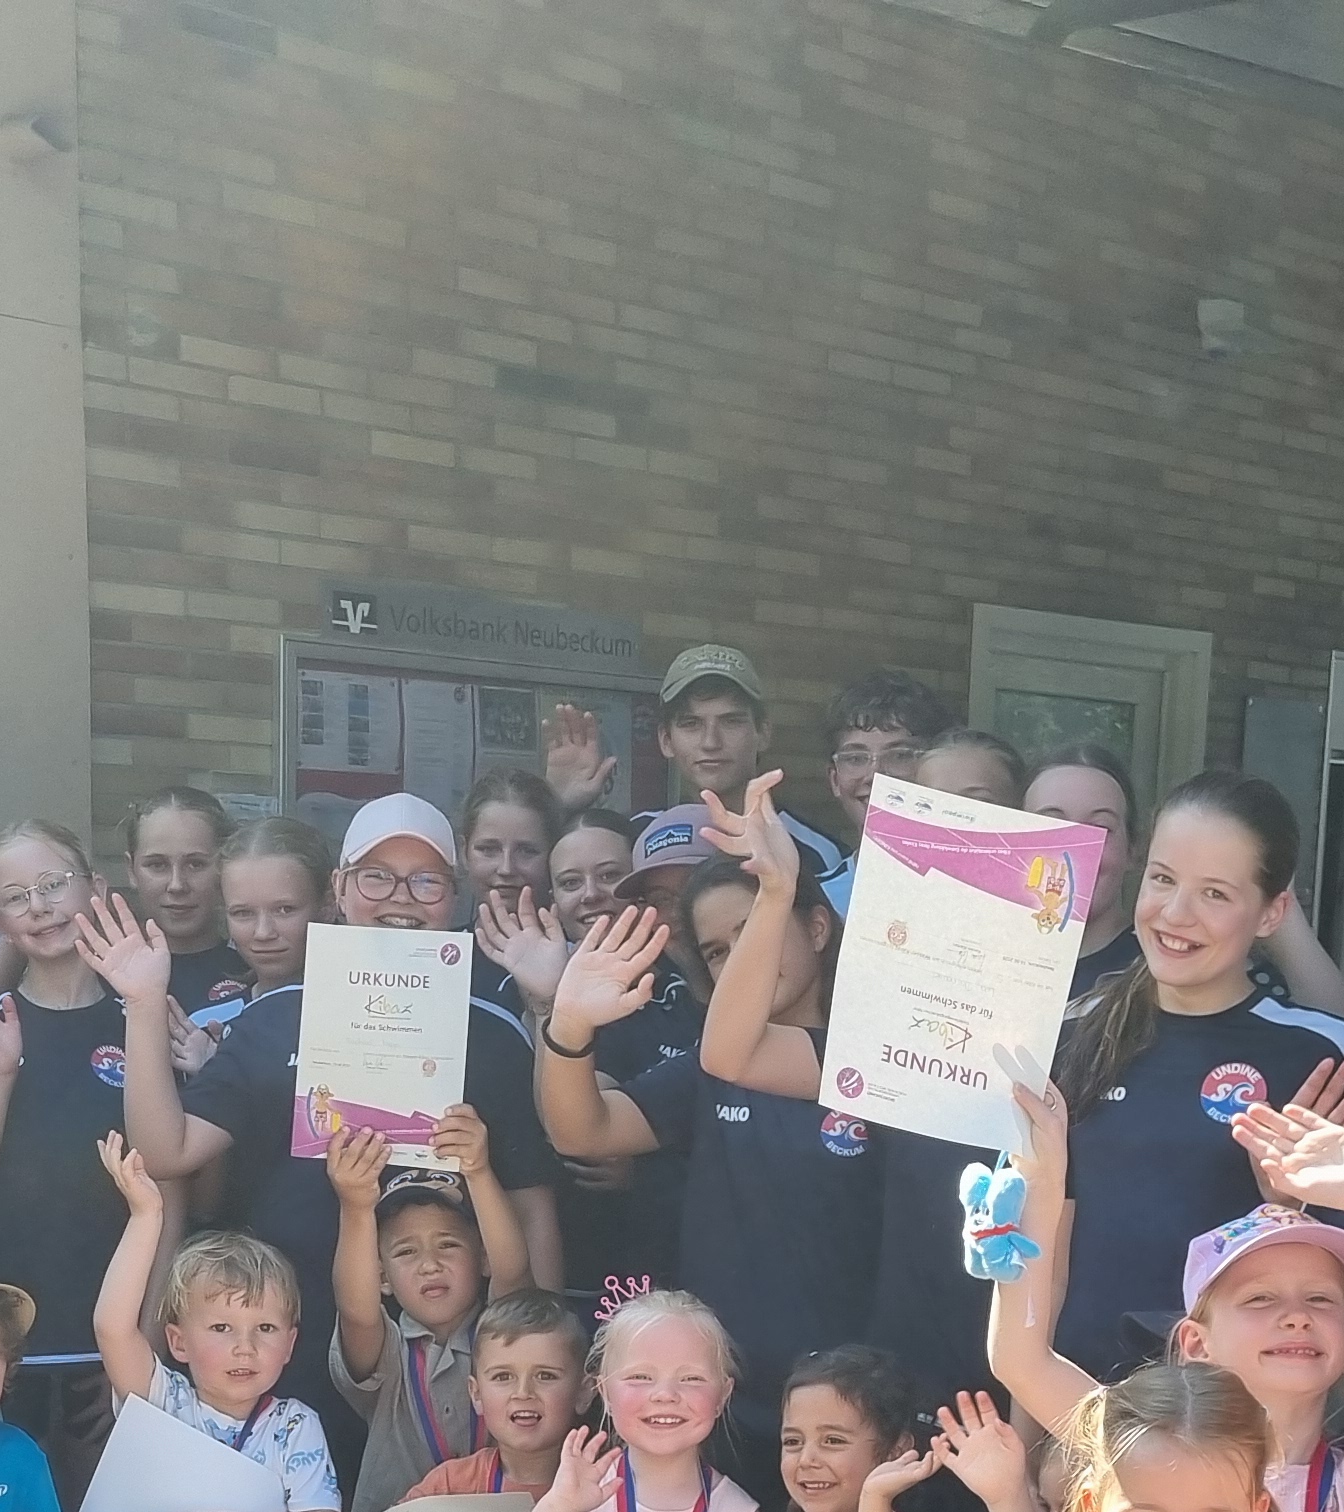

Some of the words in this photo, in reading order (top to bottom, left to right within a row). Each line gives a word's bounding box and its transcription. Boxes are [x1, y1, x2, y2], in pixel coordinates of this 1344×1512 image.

[390, 604, 506, 645] Volksbank
[514, 620, 633, 658] Neubeckum
[349, 971, 431, 989] URKUNDE
[365, 995, 413, 1017] Kibaz
[900, 985, 958, 1010] Schwimmen
[960, 1002, 977, 1014] das
[978, 1007, 994, 1019] für
[363, 1023, 376, 1032] das
[378, 1023, 423, 1035] Schwimmen
[881, 1043, 988, 1090] URKUNDE
[1211, 1062, 1262, 1083] UNDINE
[826, 1140, 865, 1157] BECKUM
